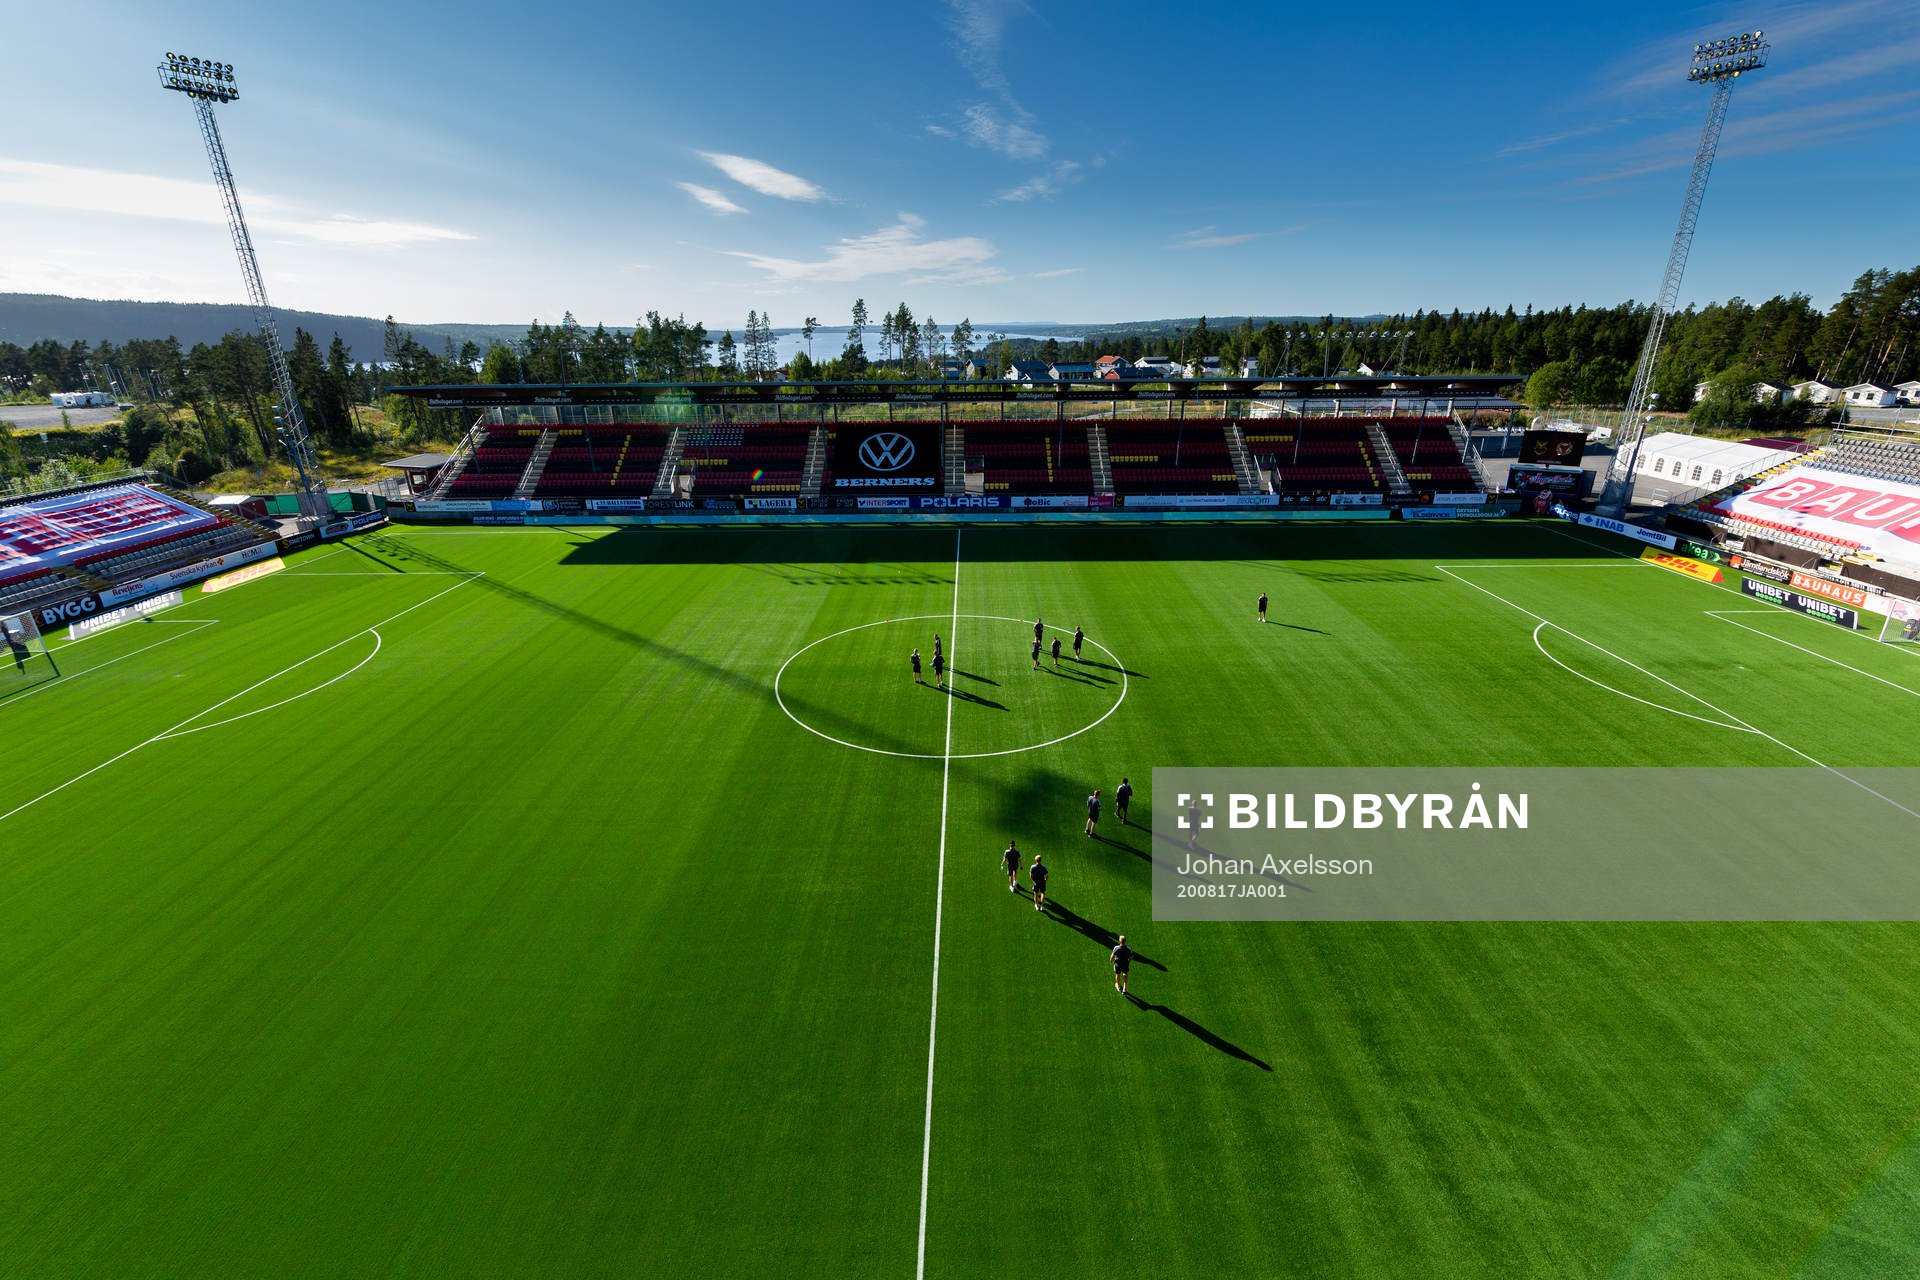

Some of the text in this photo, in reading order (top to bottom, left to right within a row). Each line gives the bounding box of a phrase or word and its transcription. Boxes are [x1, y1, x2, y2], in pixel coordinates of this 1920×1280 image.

[834, 477, 935, 487] BERNERS
[920, 497, 1000, 508] POLARIS
[1762, 480, 1920, 530] BAU
[1595, 518, 1625, 533] INAB
[170, 567, 196, 581] Svenska
[196, 560, 218, 574] kyrkan
[1748, 579, 1792, 601] UNIBET
[1797, 595, 1847, 619] UNIBET
[1793, 573, 1864, 604] BAUHAUS
[42, 596, 97, 625] BYGG
[80, 607, 127, 630] UNIBET
[134, 591, 176, 612] UNIBET
